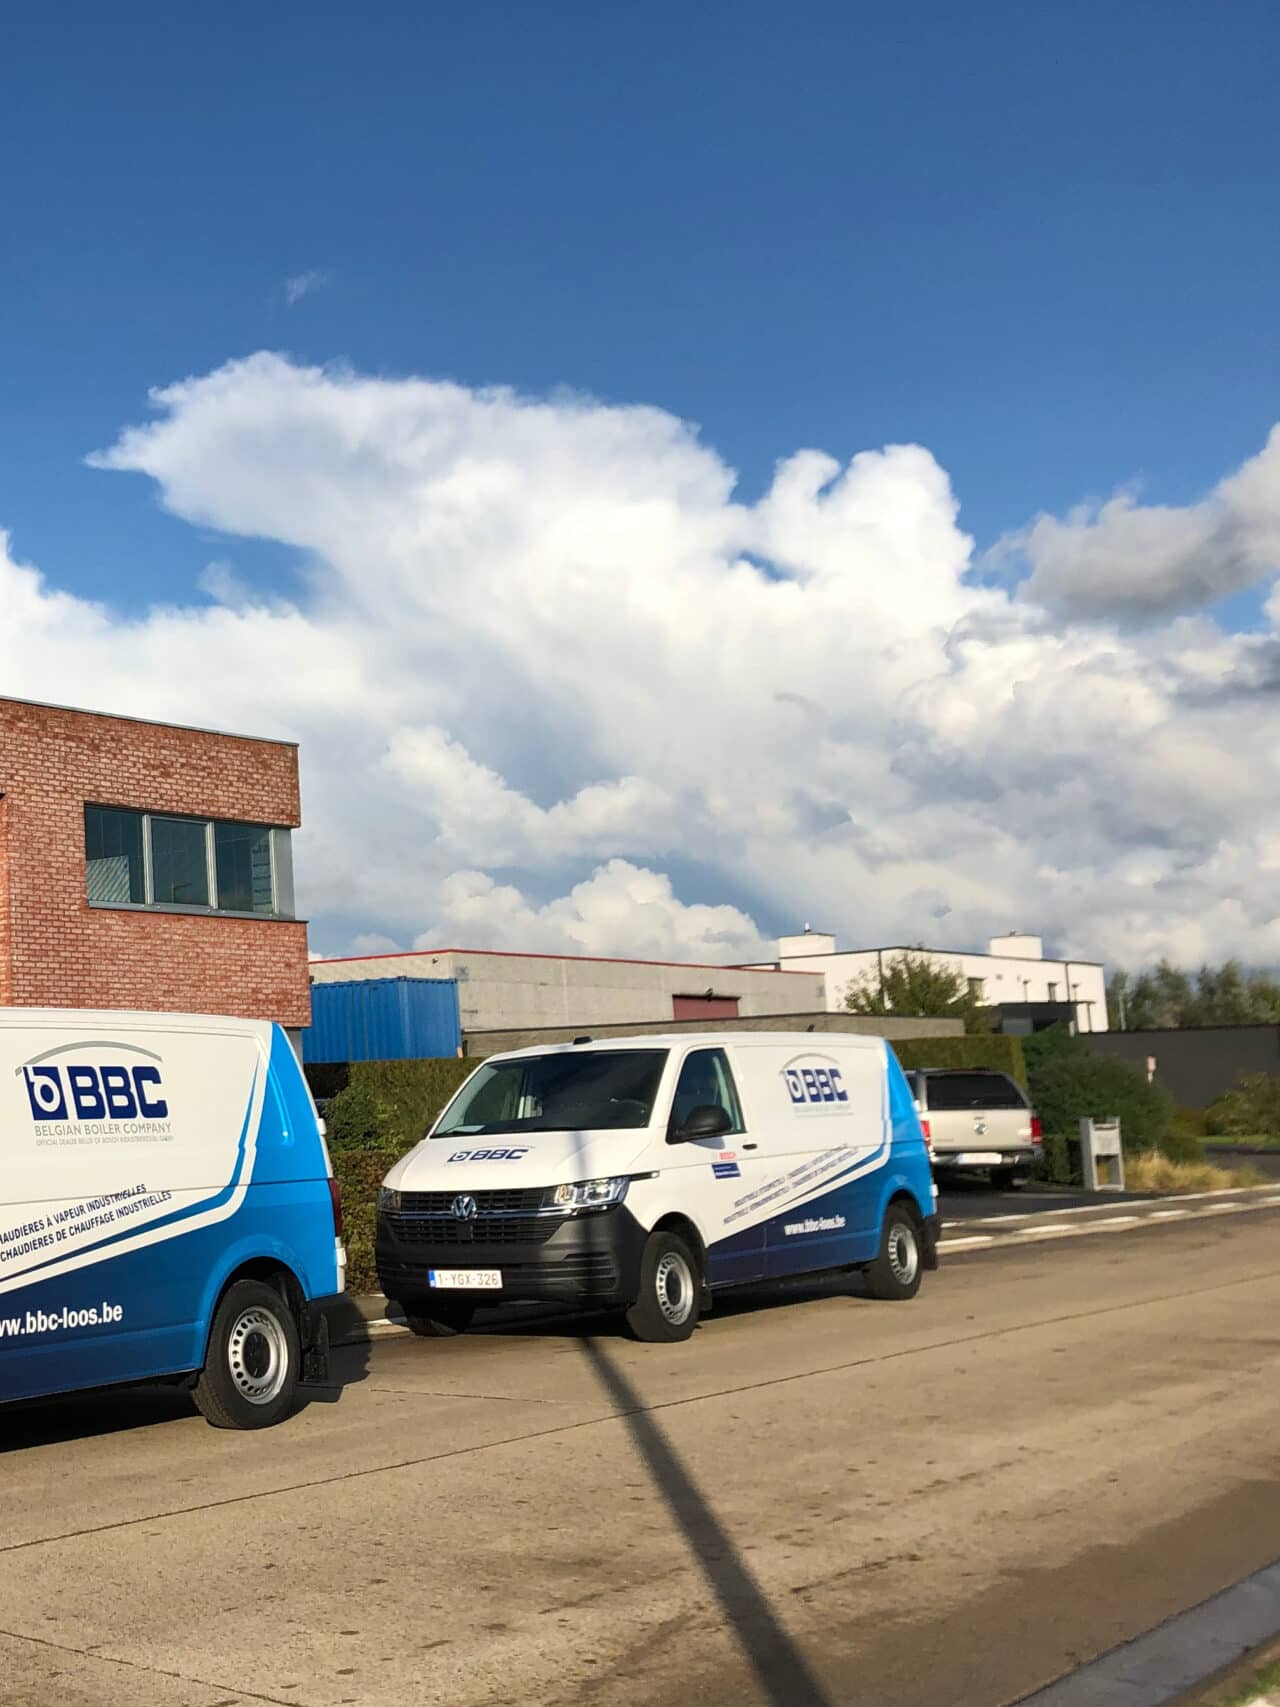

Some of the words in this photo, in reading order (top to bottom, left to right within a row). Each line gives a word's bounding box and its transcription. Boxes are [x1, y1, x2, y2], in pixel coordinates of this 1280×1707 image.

[34, 1125, 82, 1137] BELGIAN
[84, 1123, 121, 1135] BOILER
[123, 1122, 172, 1134] COMPANY
[53, 1204, 86, 1225] VAPEUR
[86, 1183, 147, 1213] INDUSTRIELLES
[56, 1228, 67, 1241] DE
[69, 1211, 115, 1237] CHAUFFAGE
[116, 1191, 172, 1219] INDUSTRIELLES
